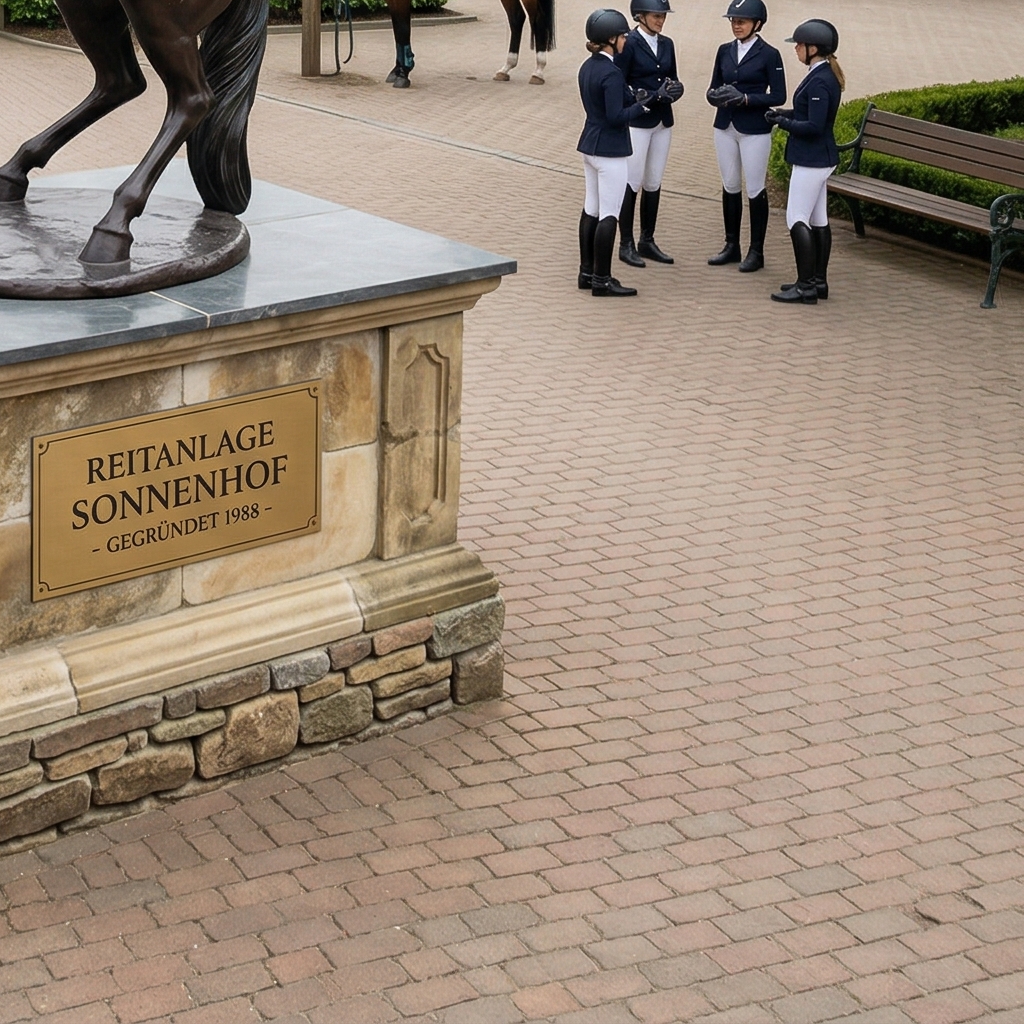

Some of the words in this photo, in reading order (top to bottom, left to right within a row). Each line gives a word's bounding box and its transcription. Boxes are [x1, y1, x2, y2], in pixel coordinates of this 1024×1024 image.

[86, 420, 275, 485] REITANLAGE
[71, 454, 288, 530] SONNENHOF
[106, 511, 220, 554] GEGRÜNDET
[225, 503, 260, 525] 1988
